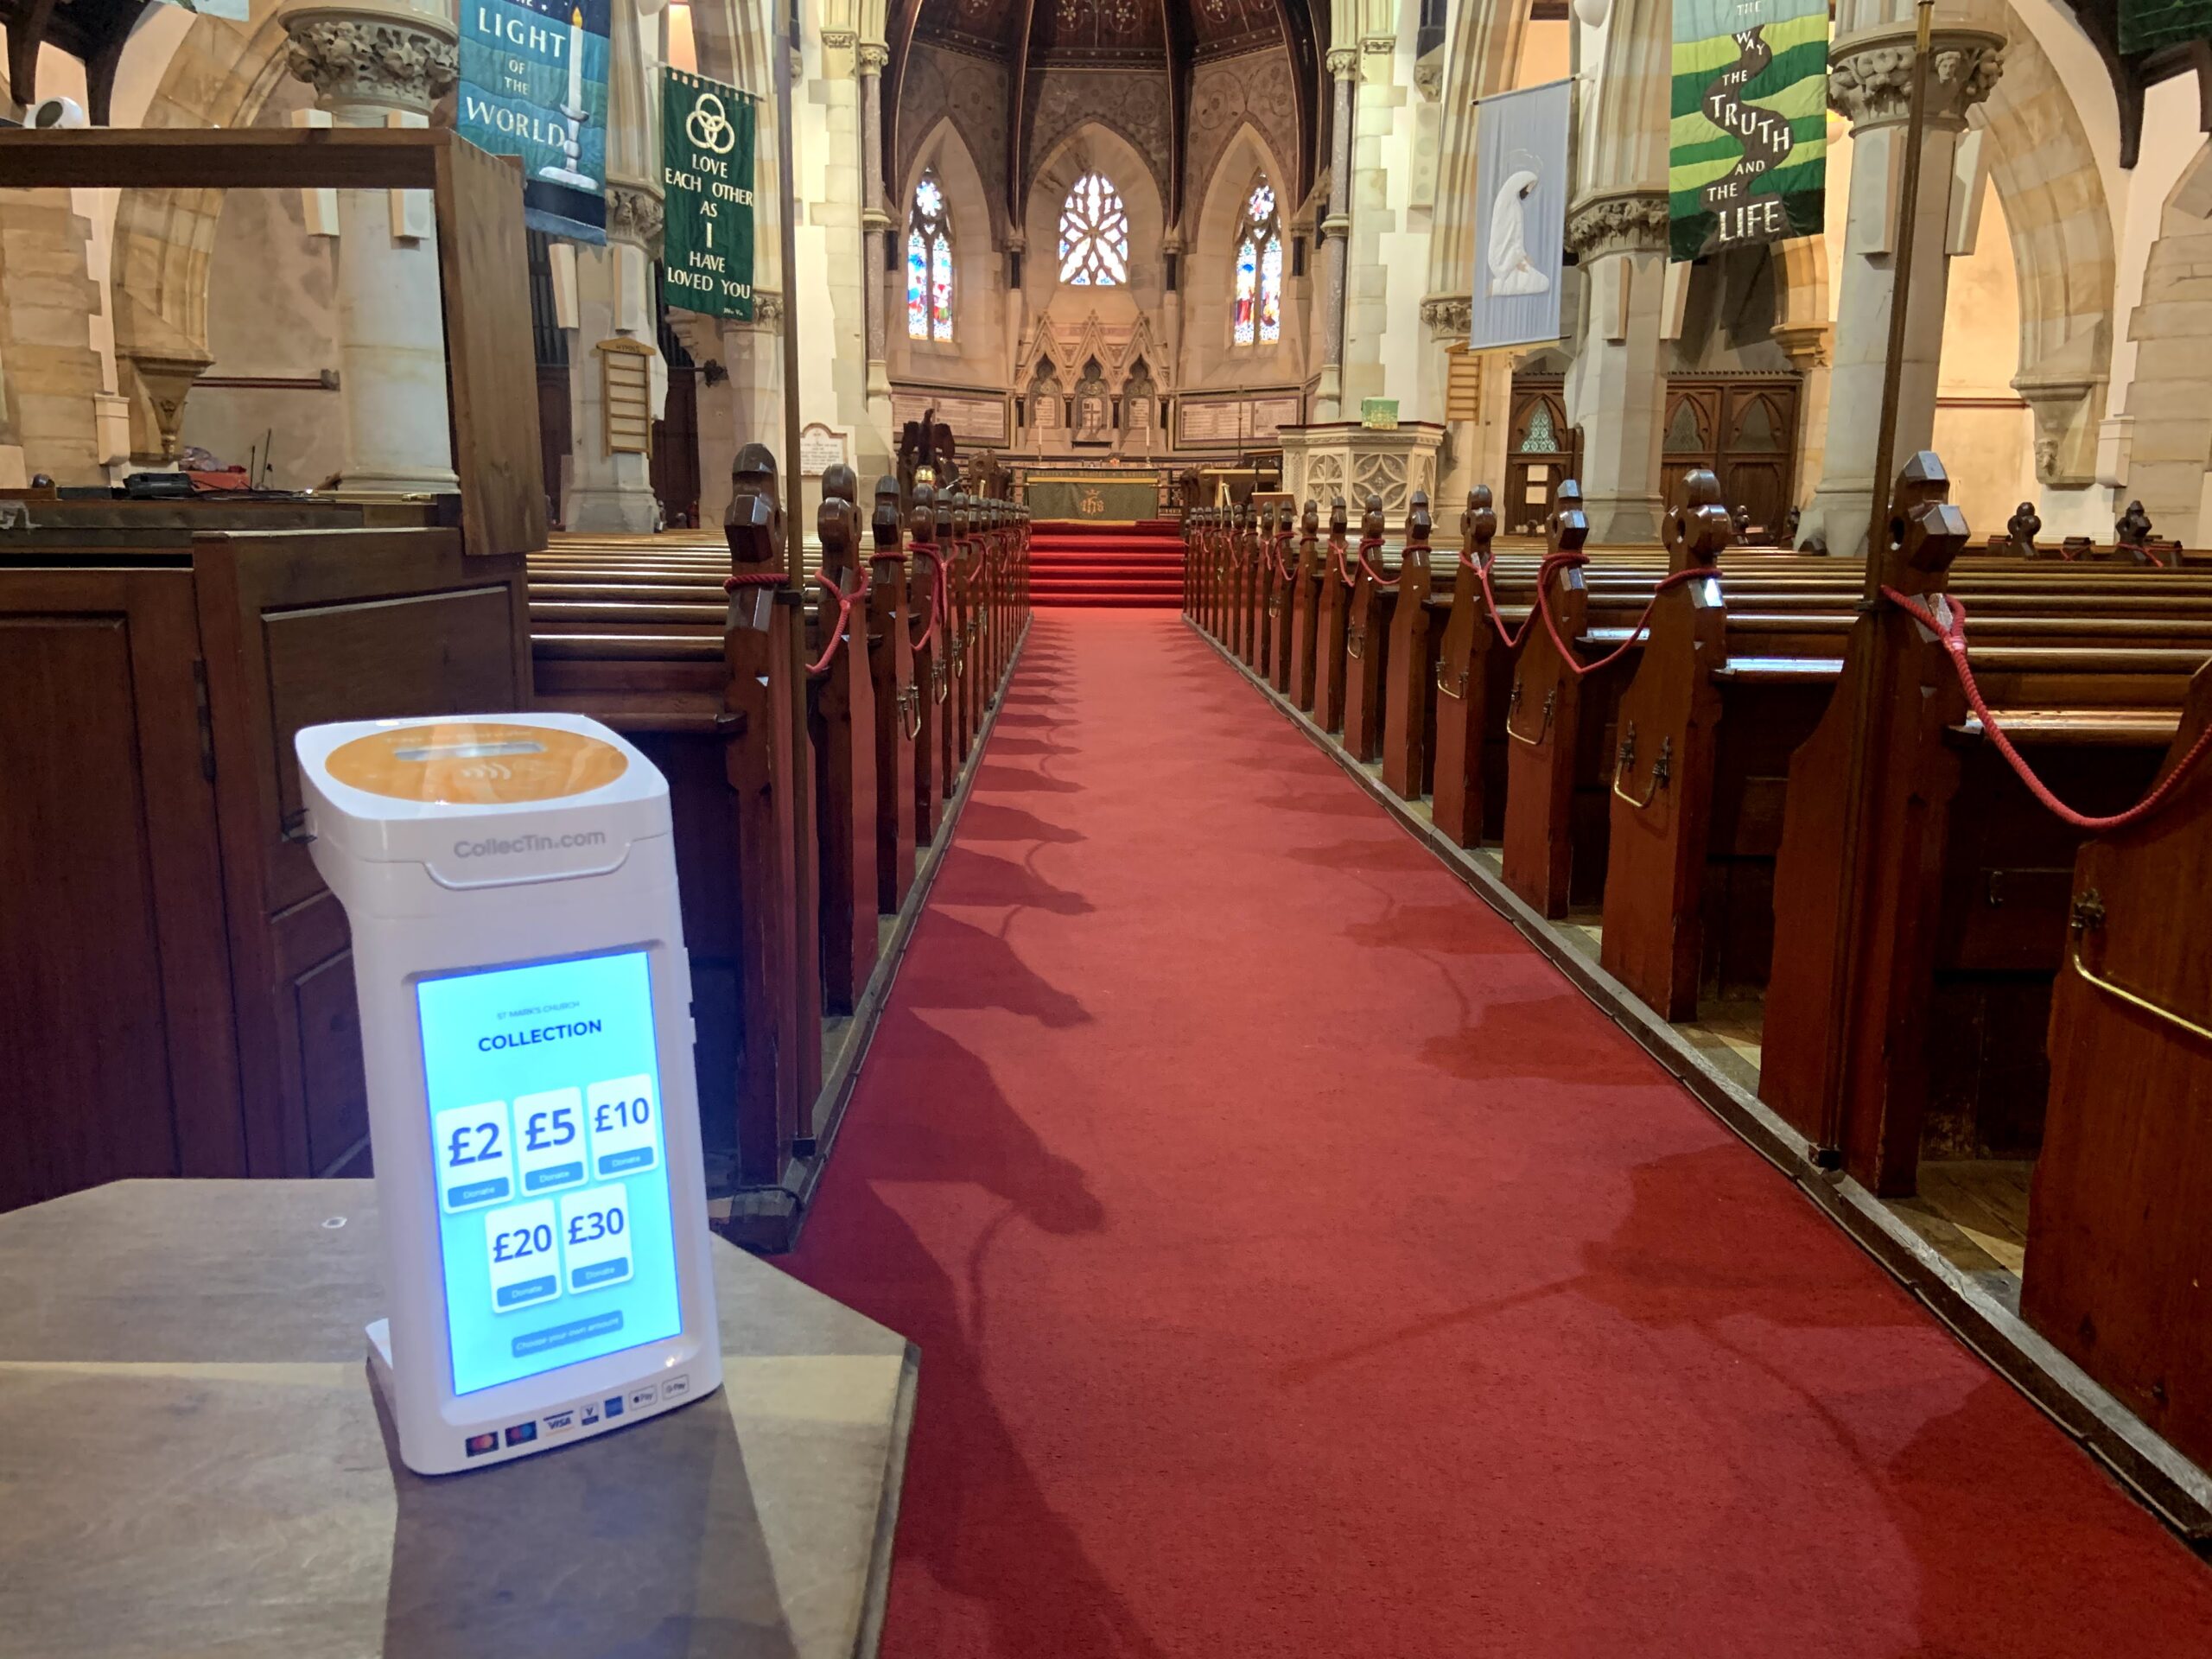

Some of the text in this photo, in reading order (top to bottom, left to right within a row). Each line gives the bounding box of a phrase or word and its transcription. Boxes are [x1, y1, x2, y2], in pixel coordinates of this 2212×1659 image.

[478, 7, 567, 58] LIGHT
[1736, 31, 1765, 56] WAY
[509, 59, 526, 75] OF
[1722, 70, 1748, 86] THE
[505, 76, 529, 95] THE
[466, 96, 567, 149] WORLD
[1710, 94, 1789, 154] TRUTH
[691, 153, 728, 179] LOVE
[1734, 160, 1765, 176] AND
[664, 167, 753, 207] EACH OTHER
[1707, 183, 1738, 202] THE
[700, 200, 718, 218] AS
[1719, 200, 1780, 243] LIFE
[705, 223, 713, 249] I
[690, 251, 726, 273] HAVE
[668, 267, 751, 300] LOVED YOU
[454, 830, 606, 860] CollecTin.com
[543, 1001, 580, 1013] CHURCH
[478, 1019, 603, 1052] COLLECTION
[594, 1096, 651, 1133] £10
[524, 1107, 576, 1152] £5
[448, 1122, 503, 1168] £2
[611, 1153, 641, 1168] Donate
[538, 1169, 570, 1183] Donate
[461, 1184, 496, 1199] Donate
[567, 1207, 625, 1246] £30
[493, 1224, 553, 1263] £20
[584, 1265, 616, 1281] Donate
[511, 1281, 543, 1299] Donate
[547, 1417, 572, 1430] VISA
